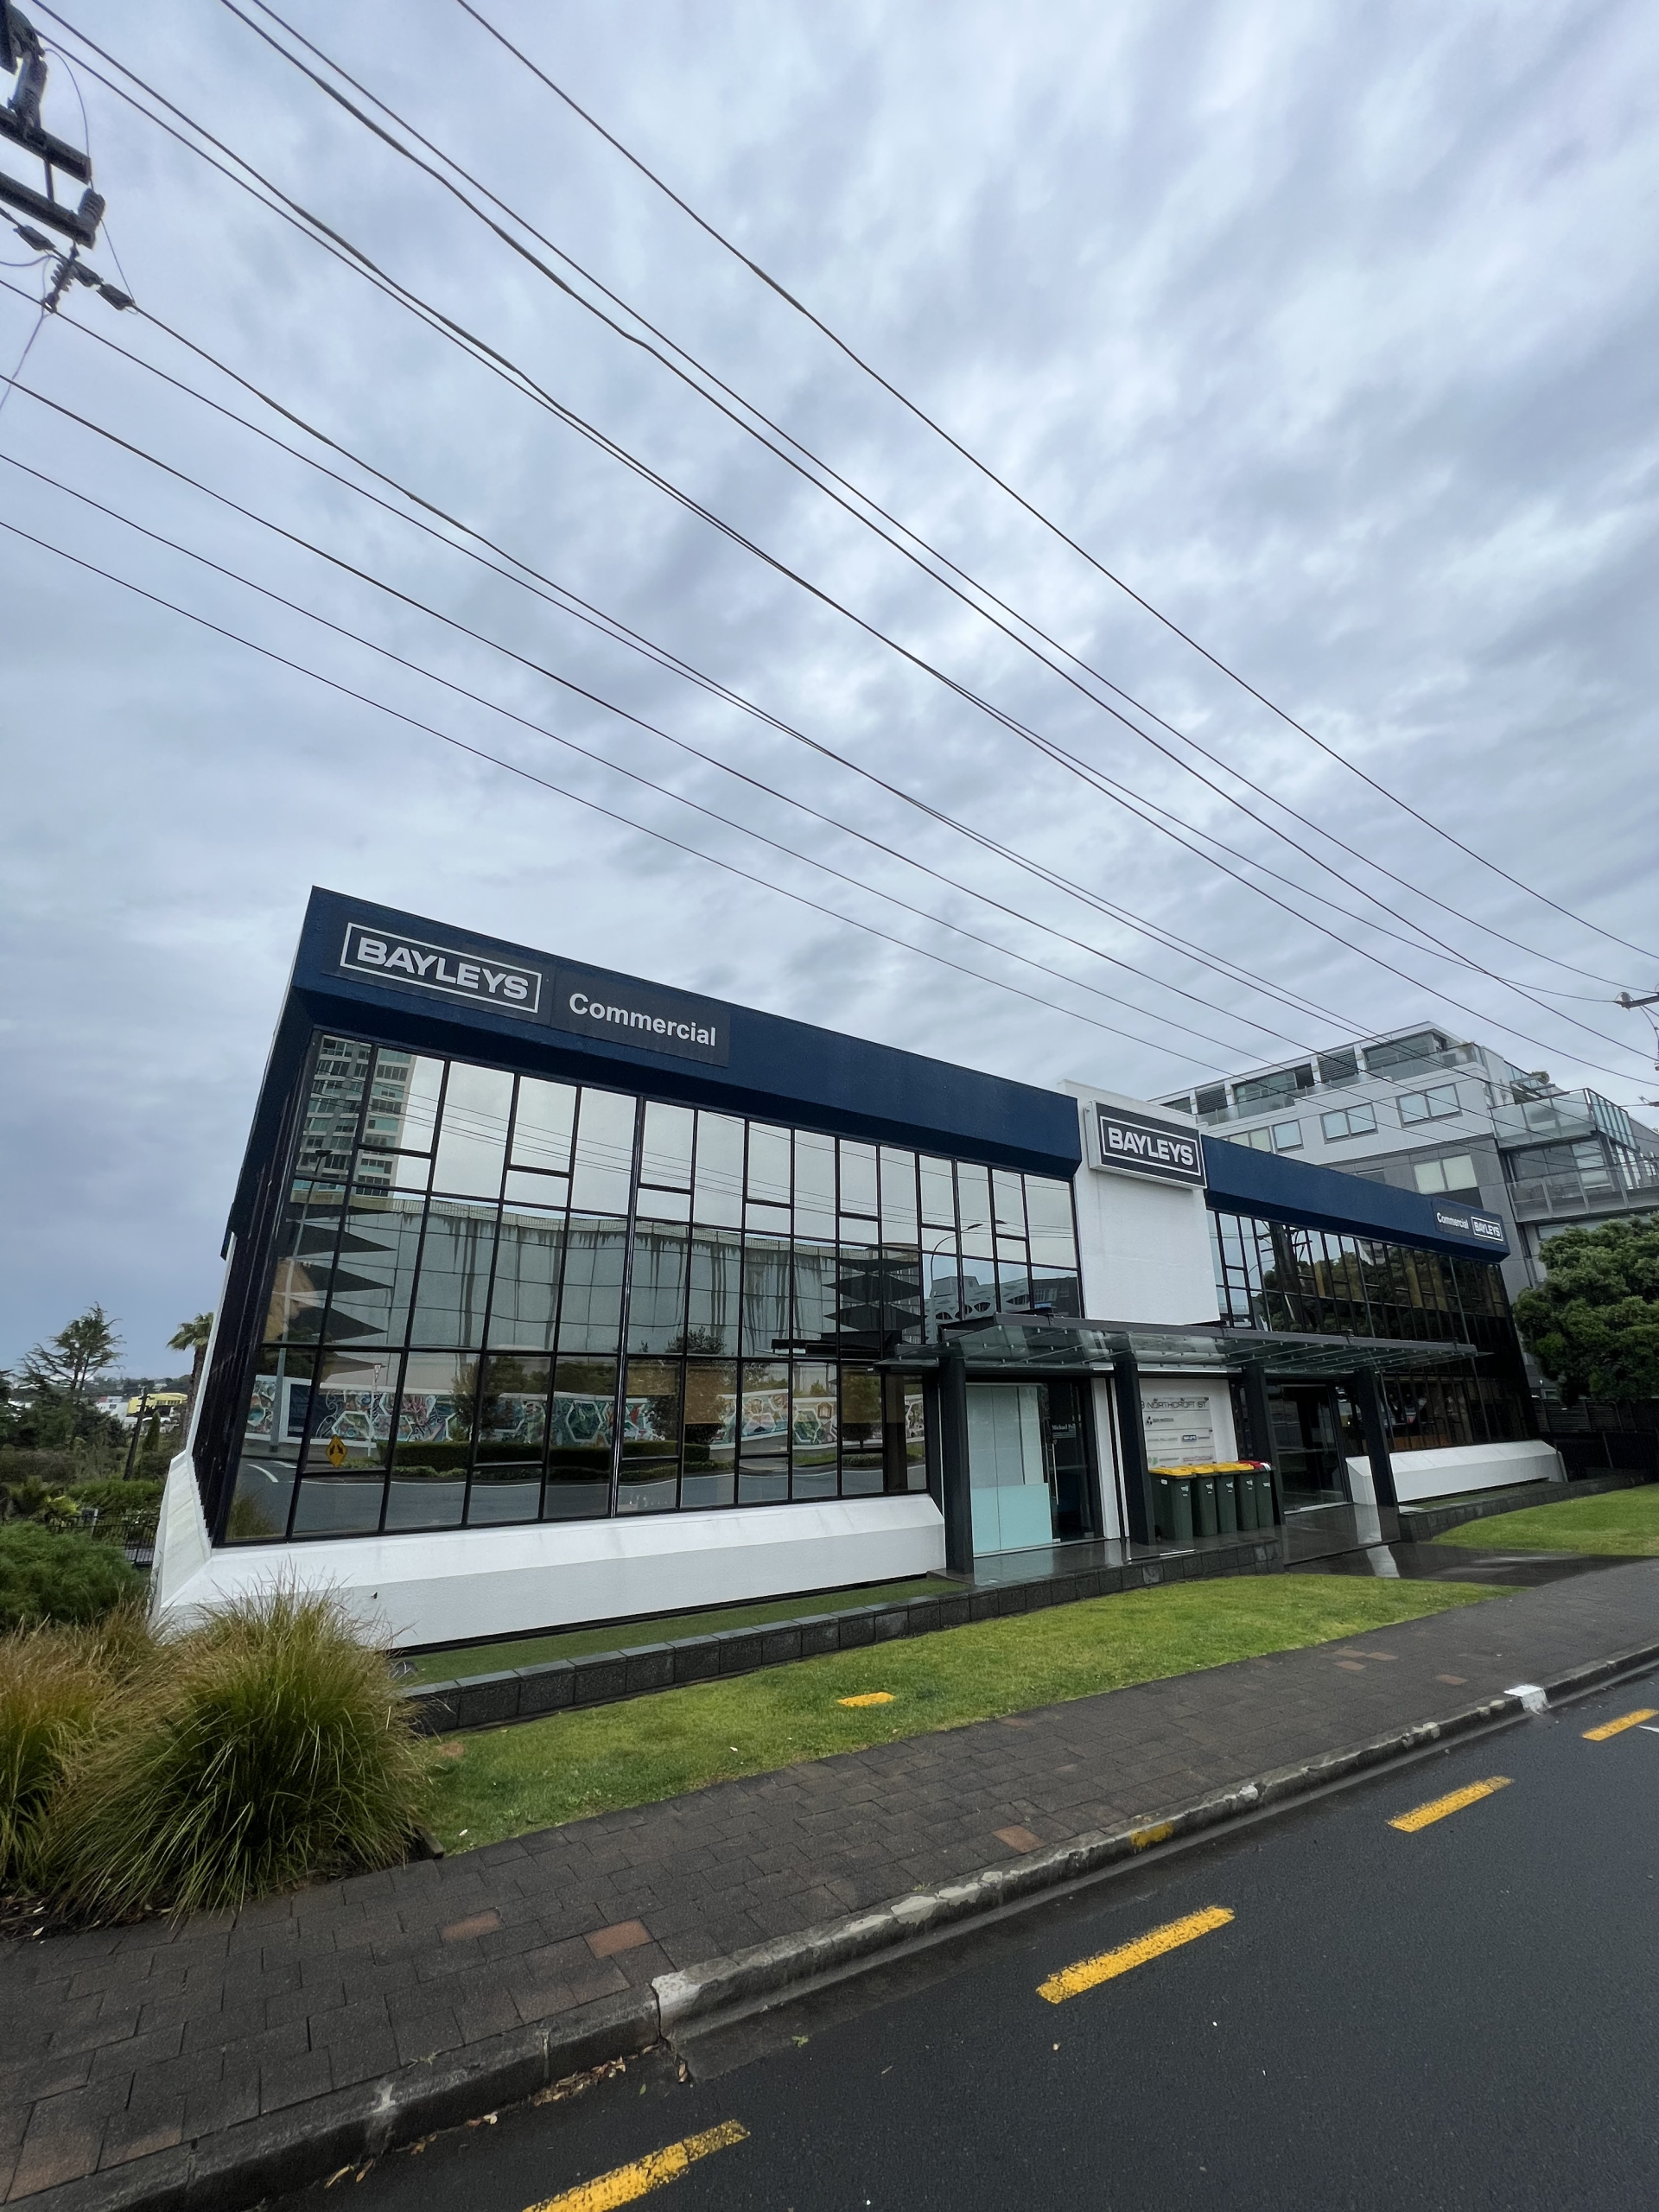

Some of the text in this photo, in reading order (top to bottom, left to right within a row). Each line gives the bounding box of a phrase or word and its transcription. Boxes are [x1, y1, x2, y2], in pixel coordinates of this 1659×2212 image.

[357, 937, 529, 1000] BAYLEYS
[569, 993, 716, 1046] Commercial
[1108, 1127, 1194, 1166] BAYLEYS
[1436, 1212, 1469, 1229] Commercial
[1473, 1221, 1501, 1237] BAYLEYS
[1147, 1401, 1195, 1409] NORTHCROFT
